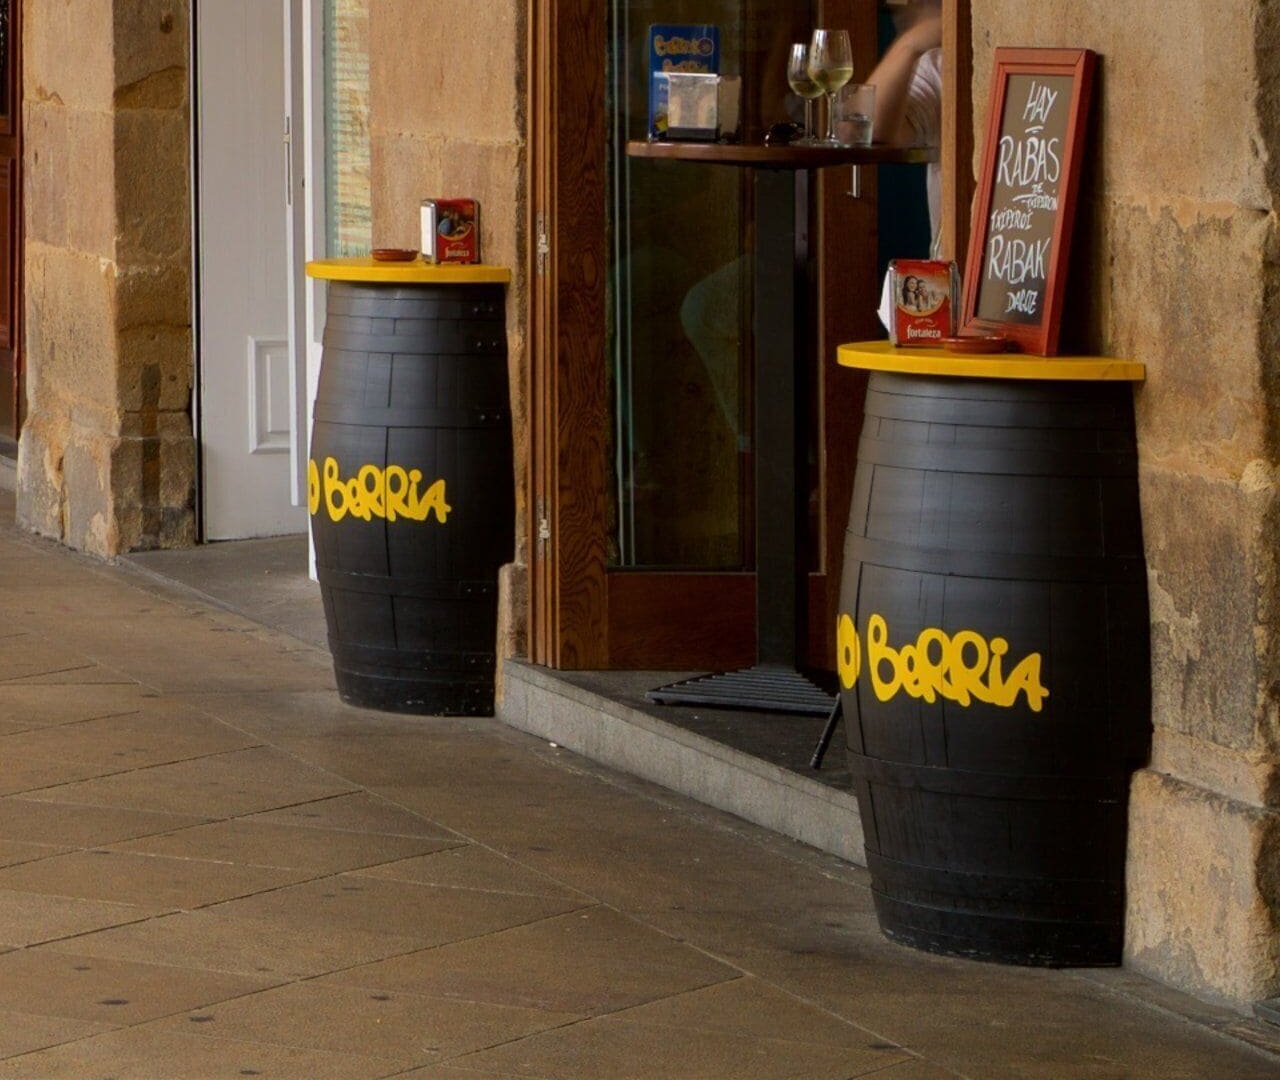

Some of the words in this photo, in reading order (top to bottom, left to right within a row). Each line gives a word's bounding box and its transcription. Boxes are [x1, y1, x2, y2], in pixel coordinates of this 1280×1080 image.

[1022, 80, 1059, 124] HAY
[996, 135, 1060, 188] RABAS
[988, 233, 1051, 285] RABAK
[907, 324, 941, 339] fortaleza
